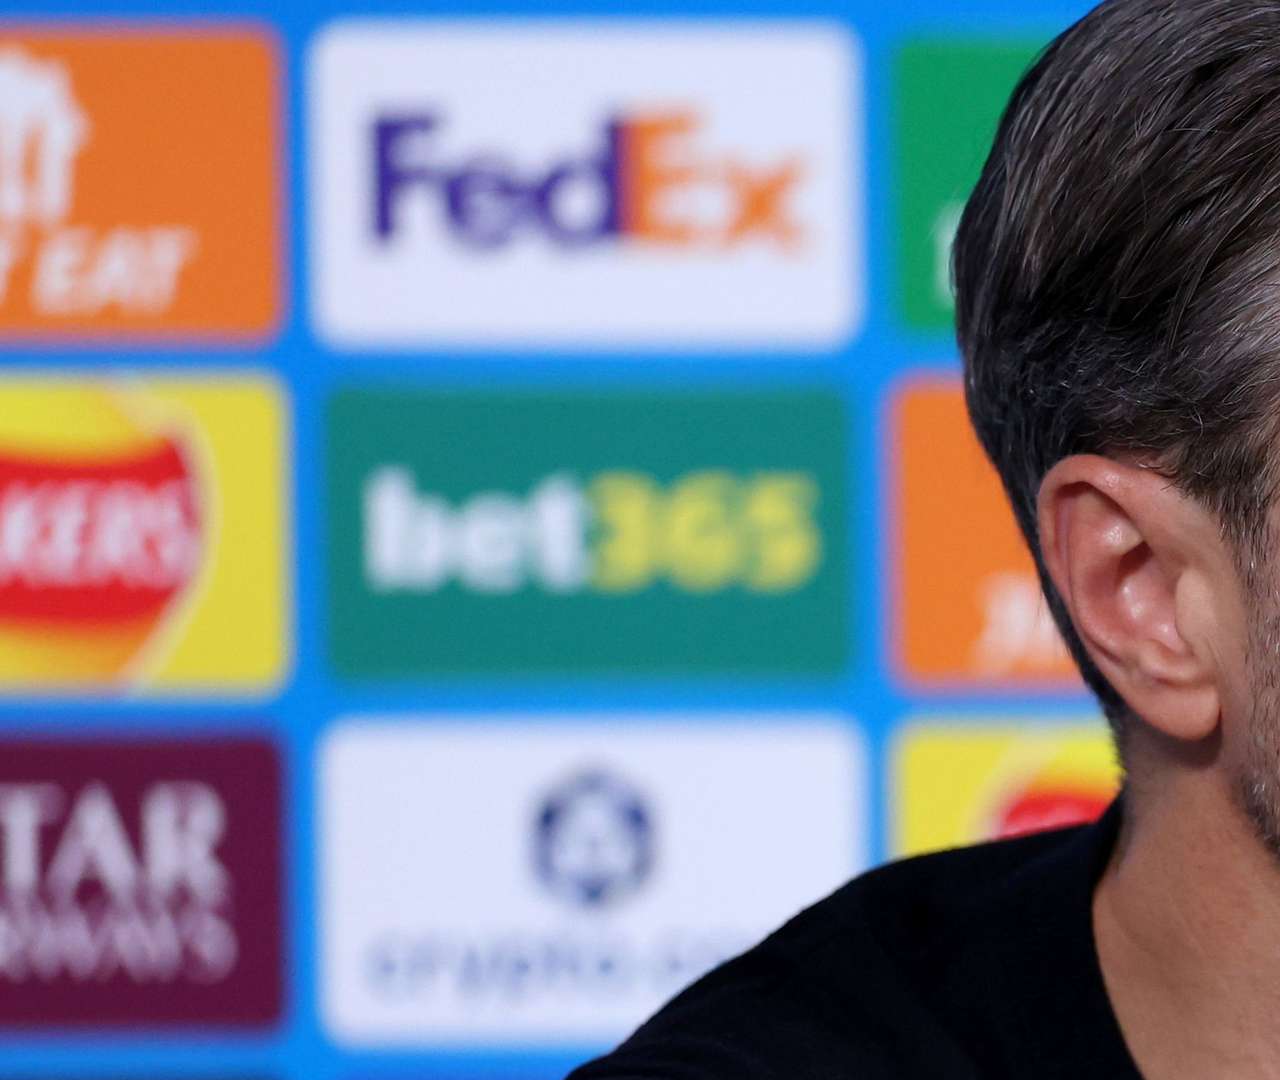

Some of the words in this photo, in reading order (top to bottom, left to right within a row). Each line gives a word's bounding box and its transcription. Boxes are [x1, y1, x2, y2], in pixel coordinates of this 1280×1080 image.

[368, 106, 810, 252] FedEx
[33, 226, 198, 316] EAT
[364, 466, 822, 593] bet365
